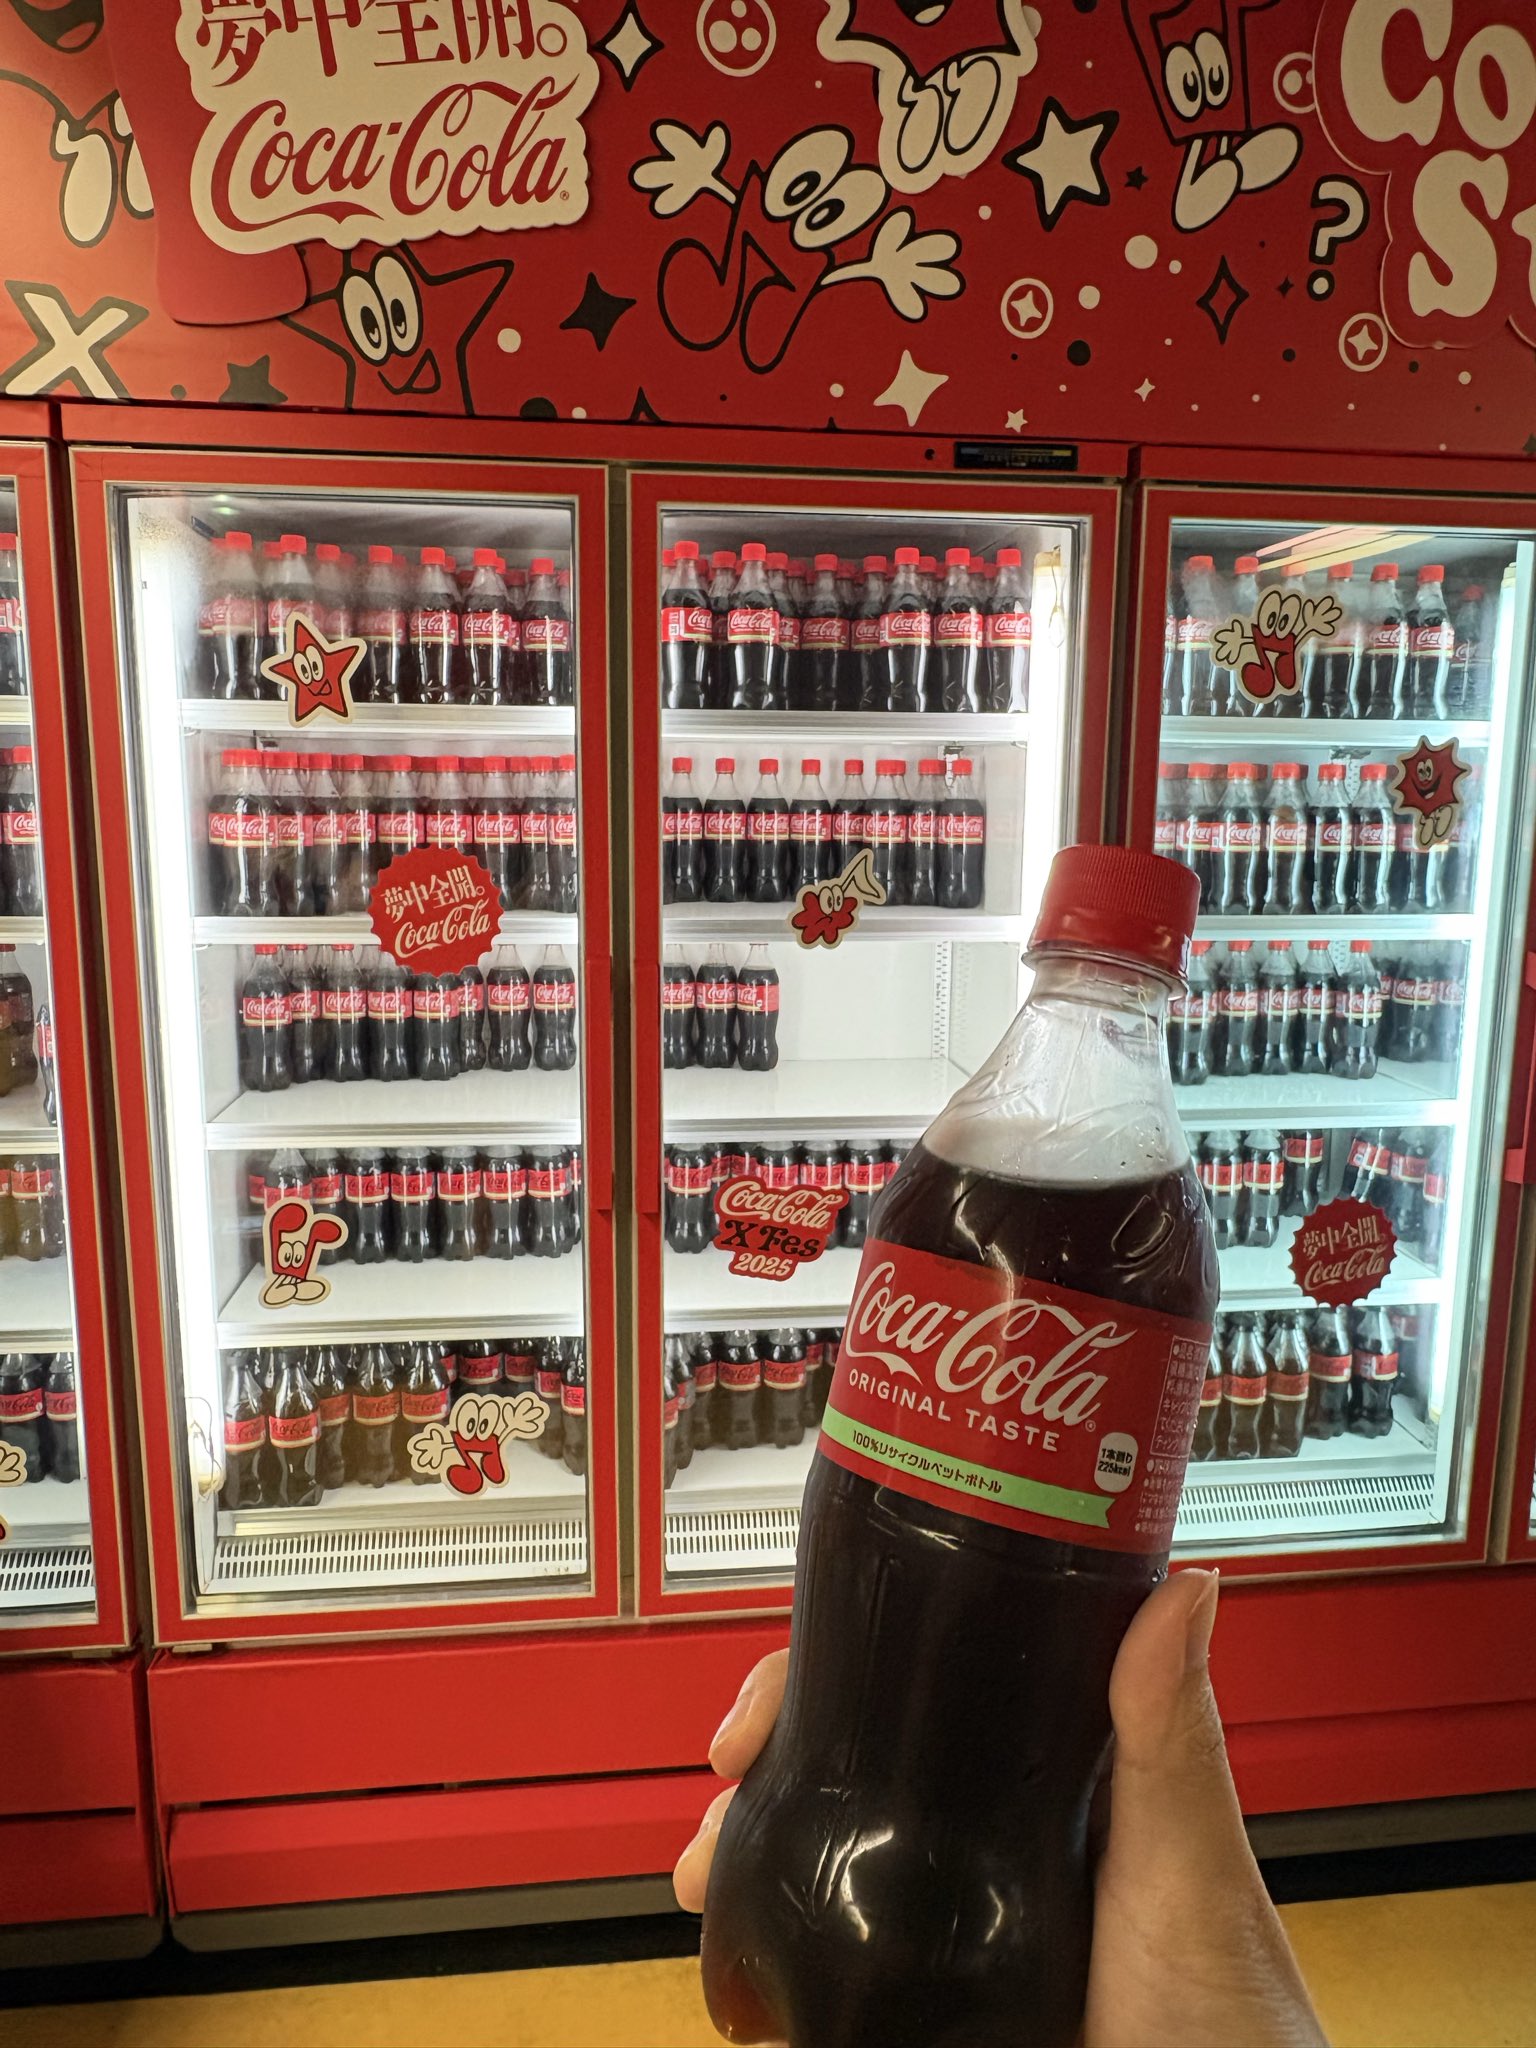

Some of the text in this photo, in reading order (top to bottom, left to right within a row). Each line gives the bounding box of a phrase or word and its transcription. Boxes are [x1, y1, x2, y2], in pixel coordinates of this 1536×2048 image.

[210, 74, 579, 231] Coca-Cola
[1408, 150, 1536, 318] S
[395, 898, 490, 958] Coca-Cola
[719, 1180, 843, 1228] Coca-Cola
[721, 1220, 821, 1257] X Fes
[733, 1253, 792, 1277] 2025
[1304, 1244, 1388, 1291] Coca-Cola
[846, 1261, 1137, 1427] Coca-Cola
[849, 1368, 1060, 1453] ORIGINAL TASTE
